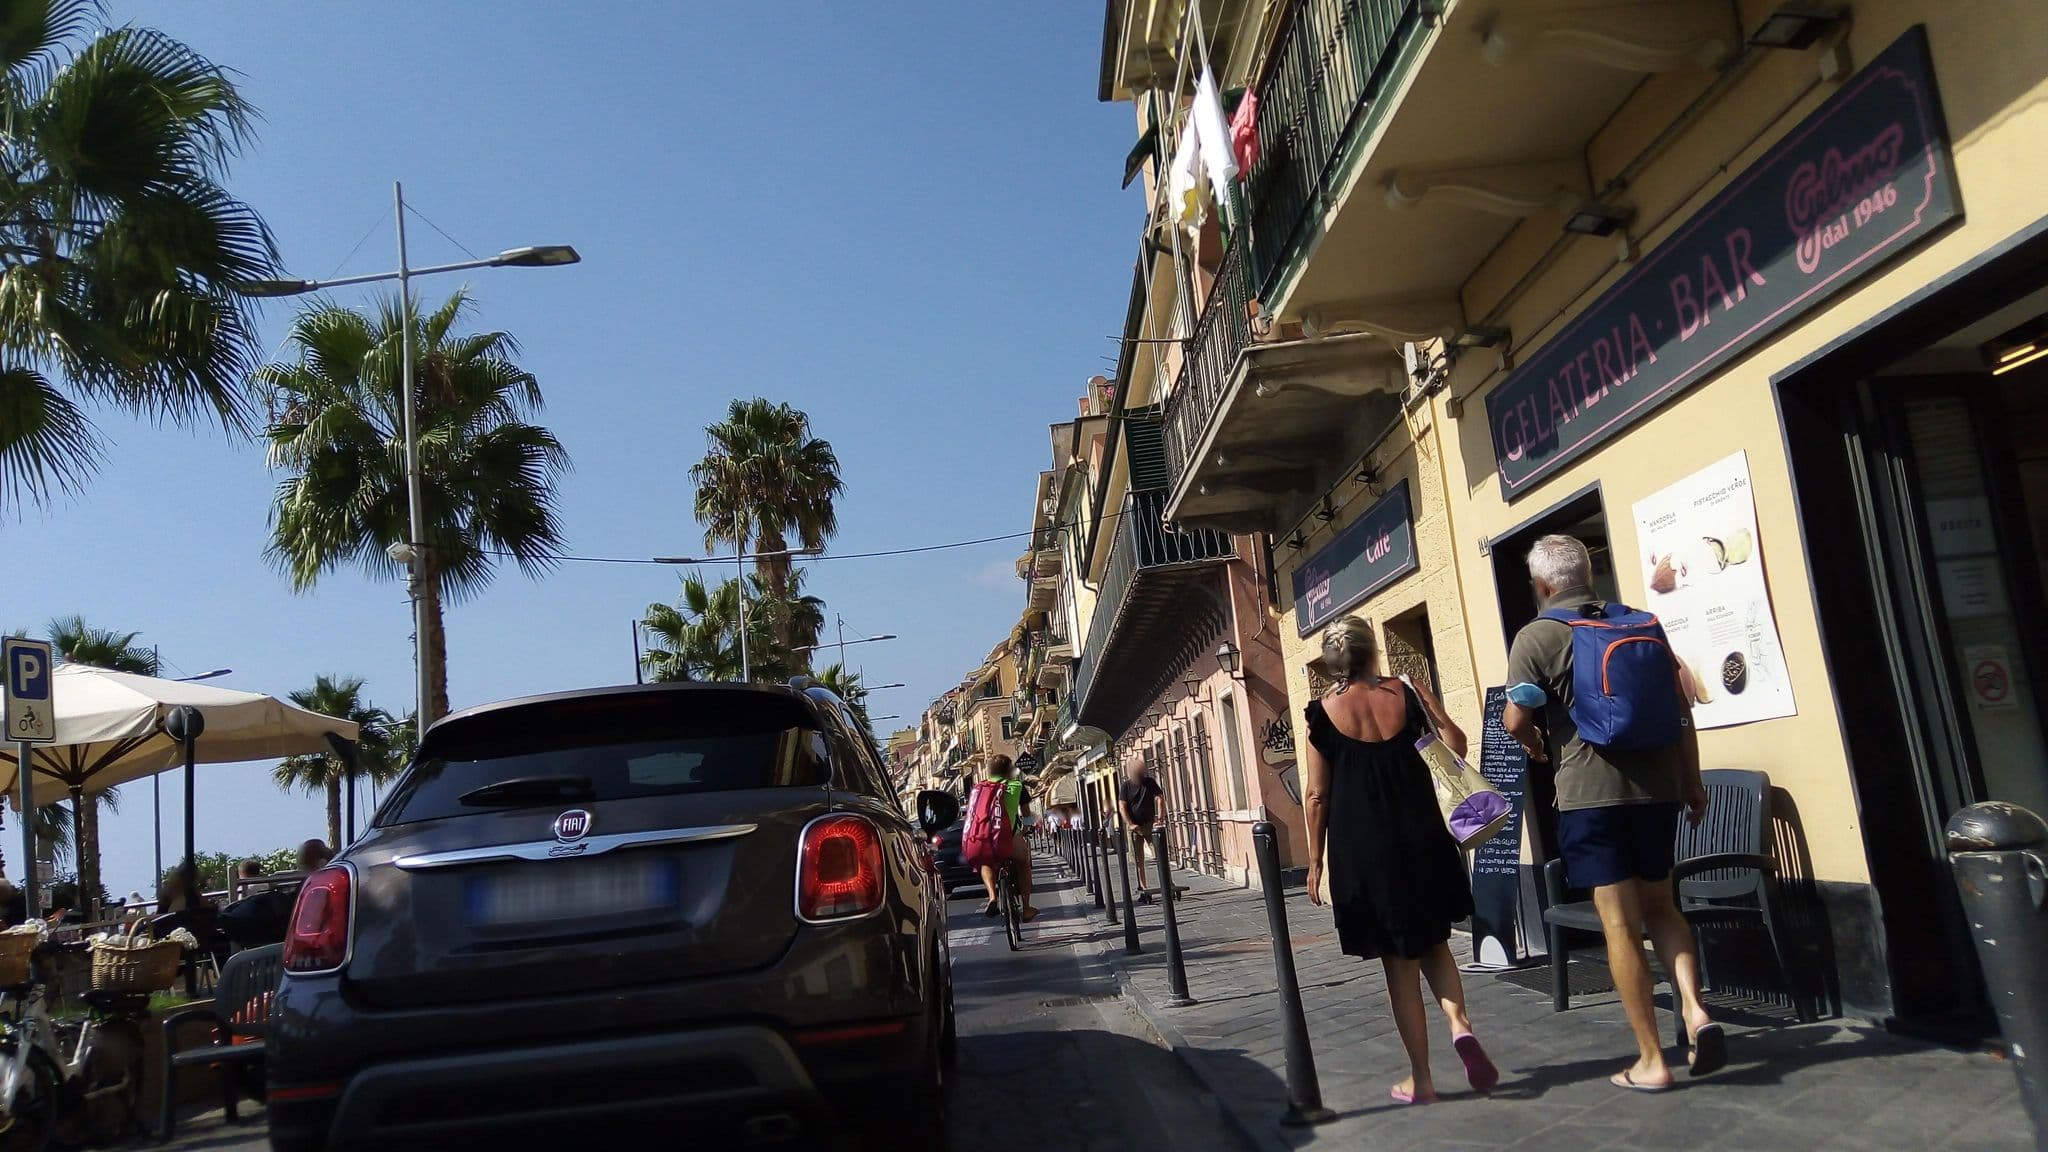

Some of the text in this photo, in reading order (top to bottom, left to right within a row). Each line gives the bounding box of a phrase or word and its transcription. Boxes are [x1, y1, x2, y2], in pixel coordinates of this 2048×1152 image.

[1823, 181, 1899, 250] dal 1946
[1501, 226, 1767, 462] GELATERIA BAR
[18, 654, 40, 692] P
[563, 817, 584, 832] FIAT
